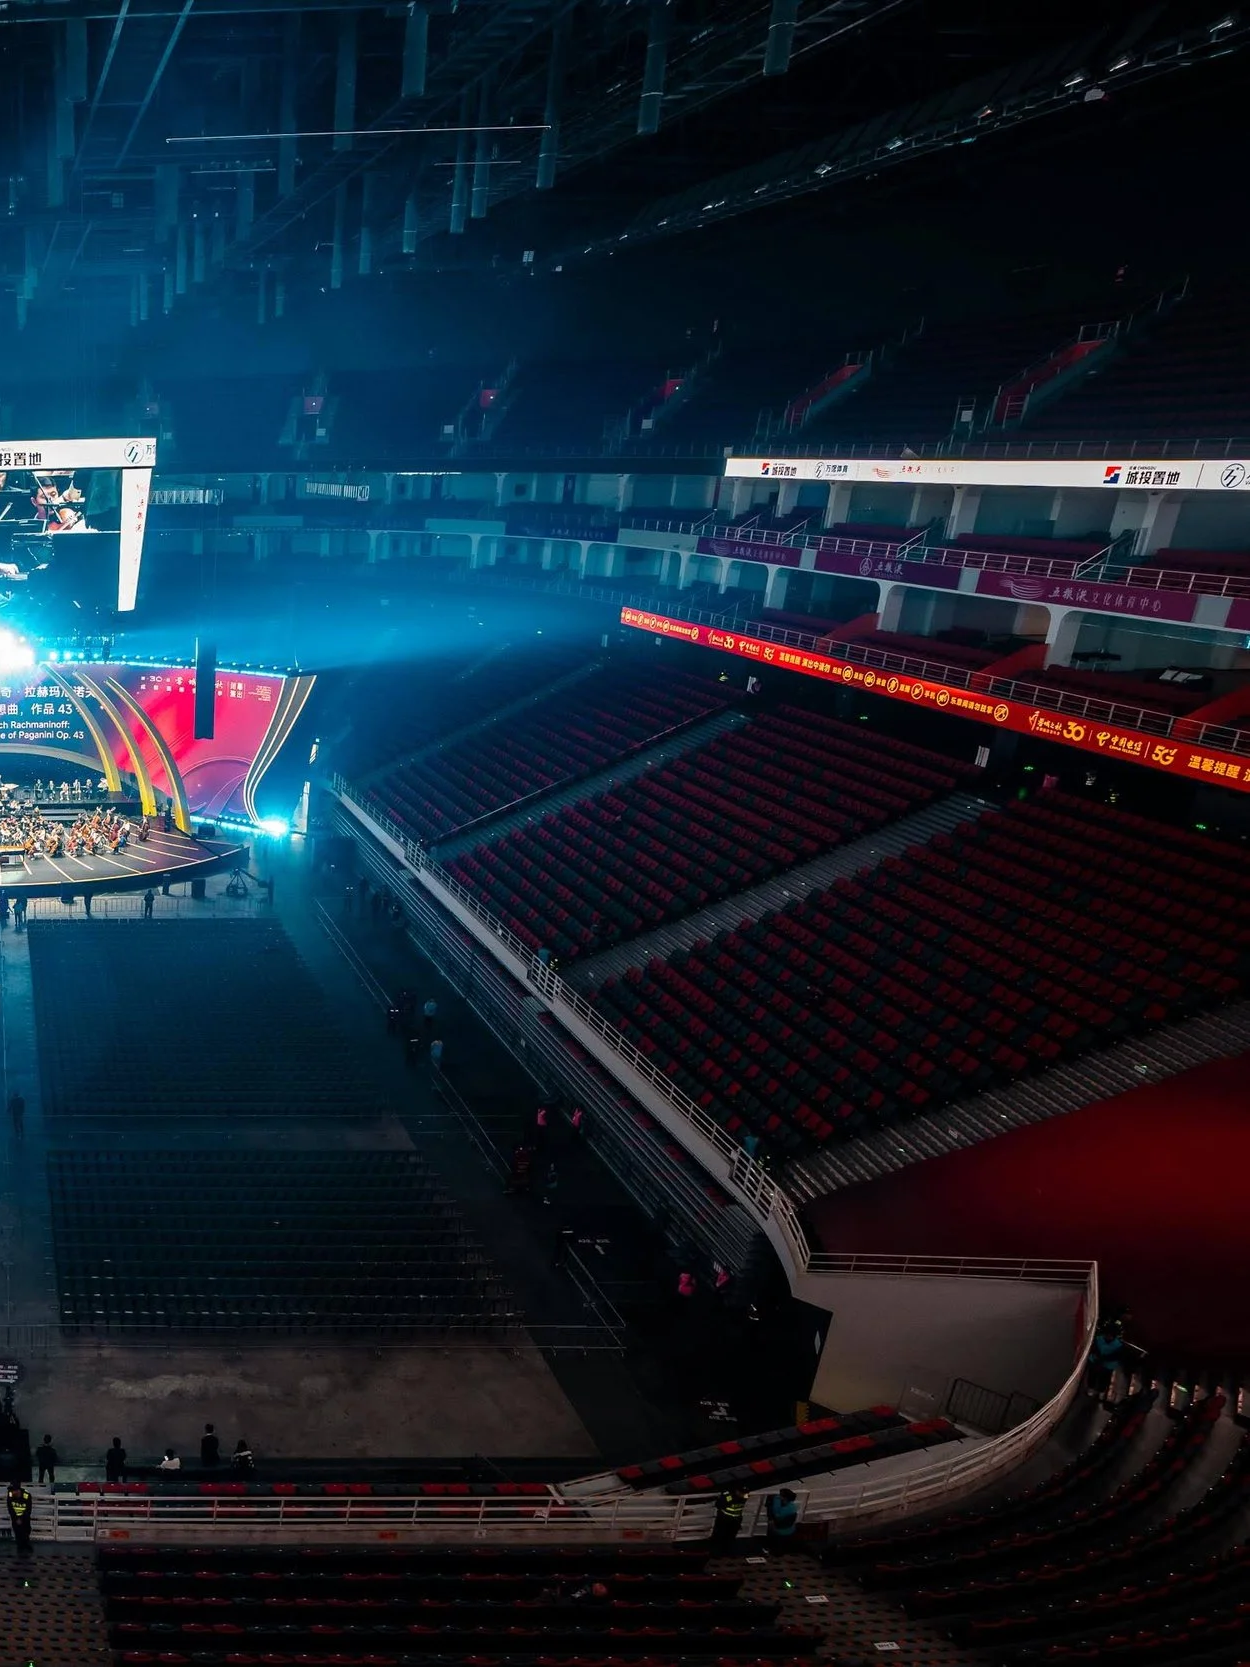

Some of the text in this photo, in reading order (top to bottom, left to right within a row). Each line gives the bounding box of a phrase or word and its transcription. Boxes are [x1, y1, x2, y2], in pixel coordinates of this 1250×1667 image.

[1125, 471, 1180, 485] 城投置地
[1048, 586, 1162, 612] 五粮液文化体育中心
[57, 703, 73, 714] 43
[10, 720, 70, 730] Rachmaninoff:
[1063, 721, 1085, 741] 30
[8, 731, 17, 739] of
[18, 731, 54, 742] Paganini
[56, 731, 71, 741] Op.
[73, 731, 84, 739] 43
[1111, 734, 1143, 751] 中国电信
[1151, 745, 1175, 765] 5G
[1188, 755, 1241, 779] 温馨提醒
